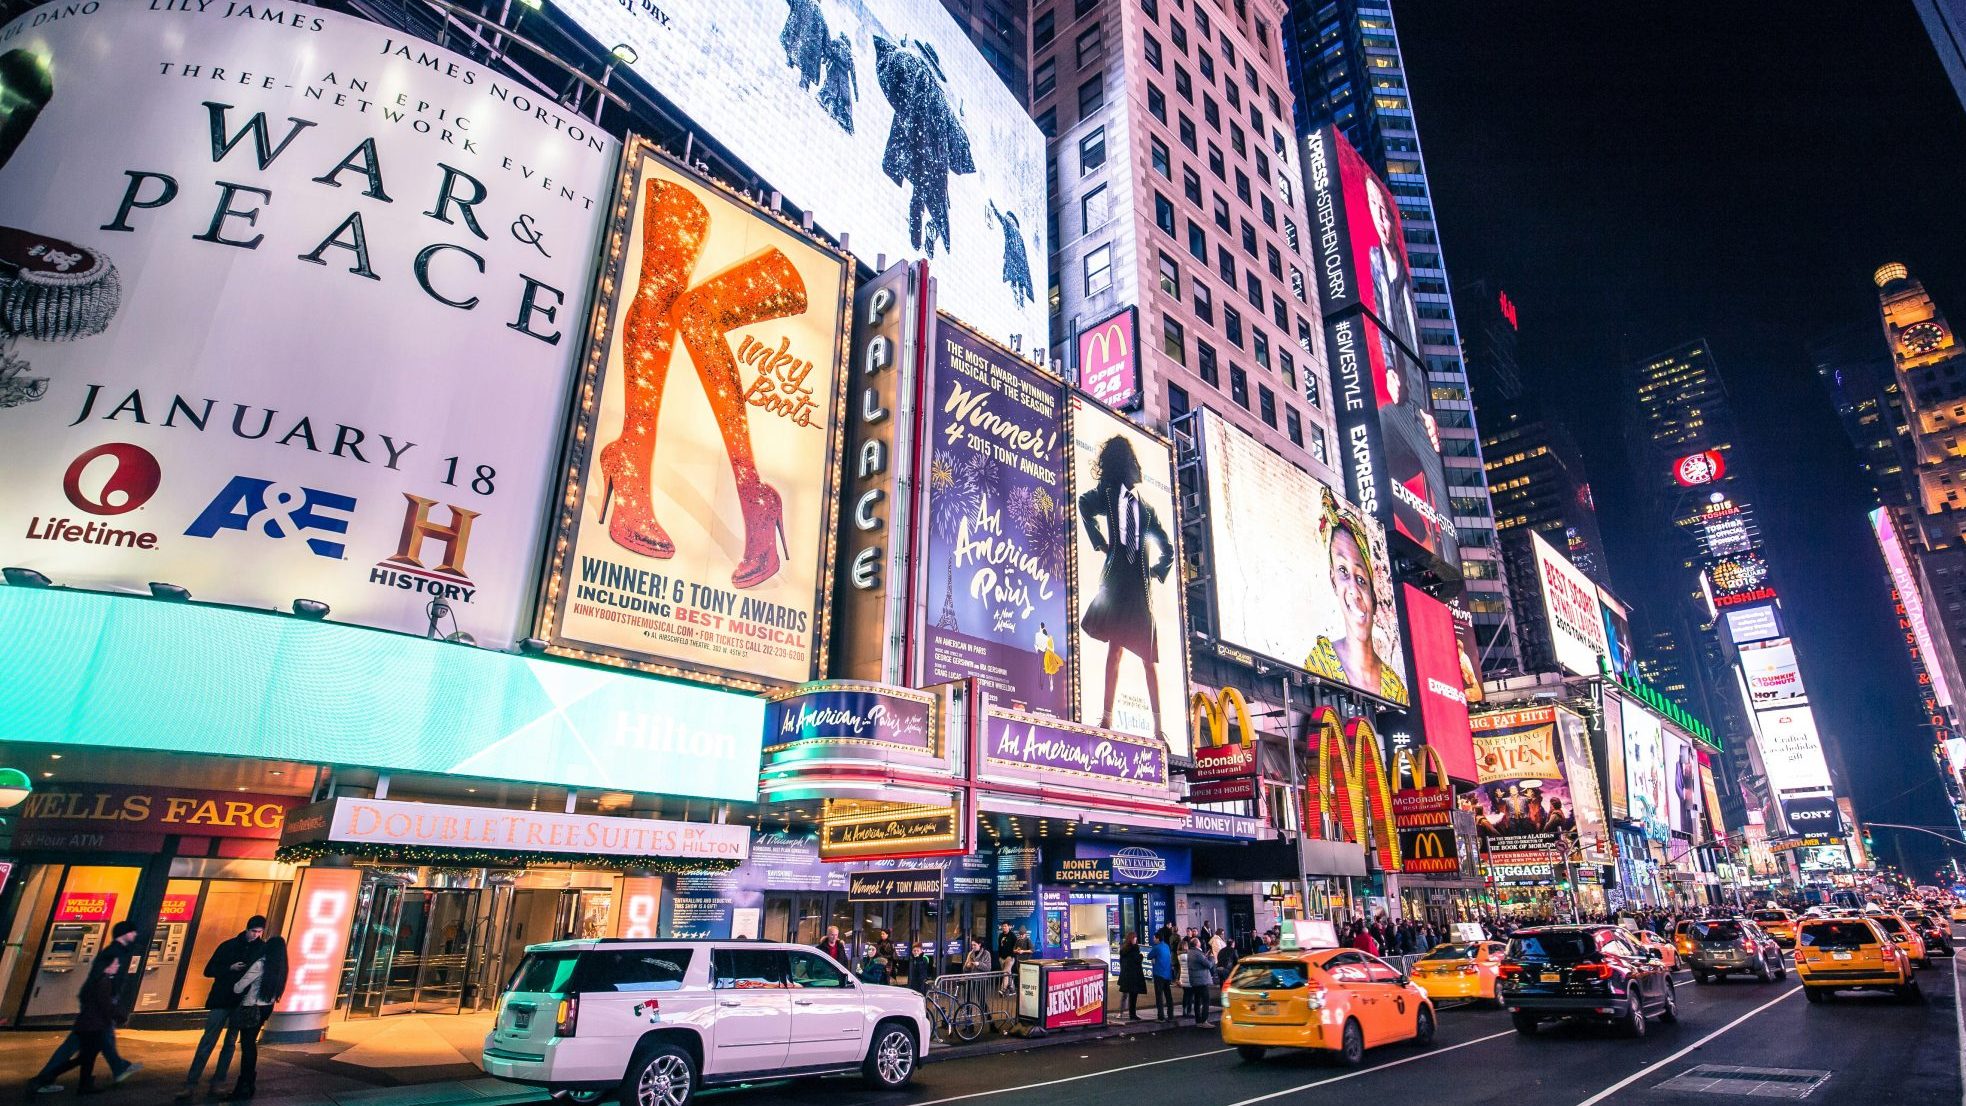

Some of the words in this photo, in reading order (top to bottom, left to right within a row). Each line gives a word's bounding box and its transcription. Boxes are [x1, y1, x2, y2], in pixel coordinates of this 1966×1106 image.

[32, 0, 100, 27] DANO
[223, 2, 325, 32] JAMES
[322, 71, 366, 93] AN
[396, 92, 471, 131] EPIC
[380, 39, 477, 85] JAMES
[489, 83, 605, 153] NORTON
[160, 62, 478, 154] THREE-NETWORK
[501, 156, 594, 210] EVENT
[202, 101, 489, 241] WAR
[511, 214, 553, 258] &
[100, 170, 564, 346] PEACE
[1325, 254, 1346, 300] CURRY
[947, 339, 964, 360] THE
[966, 348, 988, 372] MOST
[990, 359, 1055, 408] AWARD-WINNING
[951, 355, 990, 389] MUSICAL
[992, 376, 1002, 391] OF
[1004, 381, 1019, 402] THE
[1020, 389, 1053, 419] SEASON!
[1088, 361, 1125, 385] OPEN
[1094, 374, 1122, 399] 24
[744, 375, 823, 429] Boots
[944, 380, 1057, 462] Winner!
[69, 384, 417, 471] JANUARY
[440, 456, 497, 496] 18
[851, 286, 896, 592] PALACE
[945, 421, 965, 446] 4
[968, 433, 991, 457] 2015
[993, 444, 1018, 470] TONY
[1020, 457, 1056, 485] AWARDS
[1350, 424, 1378, 513] EXPRESS
[183, 475, 357, 560] A&E
[974, 493, 1003, 537] An
[1702, 506, 1741, 520] TOSHIBA
[1706, 519, 1744, 534] TOSHIBA
[26, 517, 159, 550] Lifetime
[953, 515, 1054, 600] American
[369, 567, 477, 604] HISTORY
[971, 567, 1035, 619] Paris
[1544, 558, 1567, 598] BEST
[582, 556, 668, 601] WINNER!
[672, 579, 684, 604] 6
[690, 582, 738, 616] TONY
[740, 597, 808, 634] AWARDS
[1713, 587, 1777, 607] TOSHIBA
[573, 602, 694, 638] KINKYBOOTSTHEMUSICAL.COM
[700, 630, 715, 642] FOR
[715, 633, 744, 649] TICKETS
[745, 640, 762, 653] CALL
[576, 584, 671, 618] INCLUDING
[675, 606, 725, 630] BEST
[728, 619, 806, 649] MUSICAL
[934, 653, 952, 664] GEORGE
[943, 637, 967, 650] AMERICAN
[1762, 671, 1796, 682] DUNKIN'
[1763, 678, 1796, 687] DONUTS
[1754, 691, 1779, 699] HOT
[781, 707, 794, 736] An
[795, 702, 863, 735] American
[869, 704, 901, 736] Paris
[1494, 713, 1517, 727] FAT
[616, 711, 736, 760] Hilton
[996, 723, 1020, 755] An
[1022, 725, 1091, 772] American
[1095, 741, 1129, 778] Paris
[1197, 766, 1241, 777] Restaurant
[1192, 788, 1211, 797] OPEN
[1224, 784, 1250, 794] HOURS
[1393, 793, 1450, 806] McDonald's
[21, 793, 153, 824] WELLS
[1403, 802, 1441, 811] Restaurant
[1791, 810, 1832, 820] SONY
[683, 828, 706, 840] BY
[1195, 815, 1231, 832] MONEY
[1236, 820, 1256, 835] ATM
[69, 835, 104, 847] ATM
[682, 839, 740, 854] HILTON
[1056, 869, 1110, 881] EXCHANGE
[1063, 859, 1098, 869] MONEY
[1133, 858, 1166, 869] EXCHANGE
[1487, 865, 1551, 877] LUGGAGE
[851, 877, 885, 895] Winner!
[885, 880, 894, 895] 4
[896, 881, 913, 893] TONY
[913, 880, 940, 893] AWARDS
[65, 905, 104, 914] FARGO
[67, 898, 105, 907] WELLS
[162, 900, 186, 908] ELLS
[1047, 986, 1081, 1016] JERSEY
[1083, 979, 1104, 1006] BOYS
